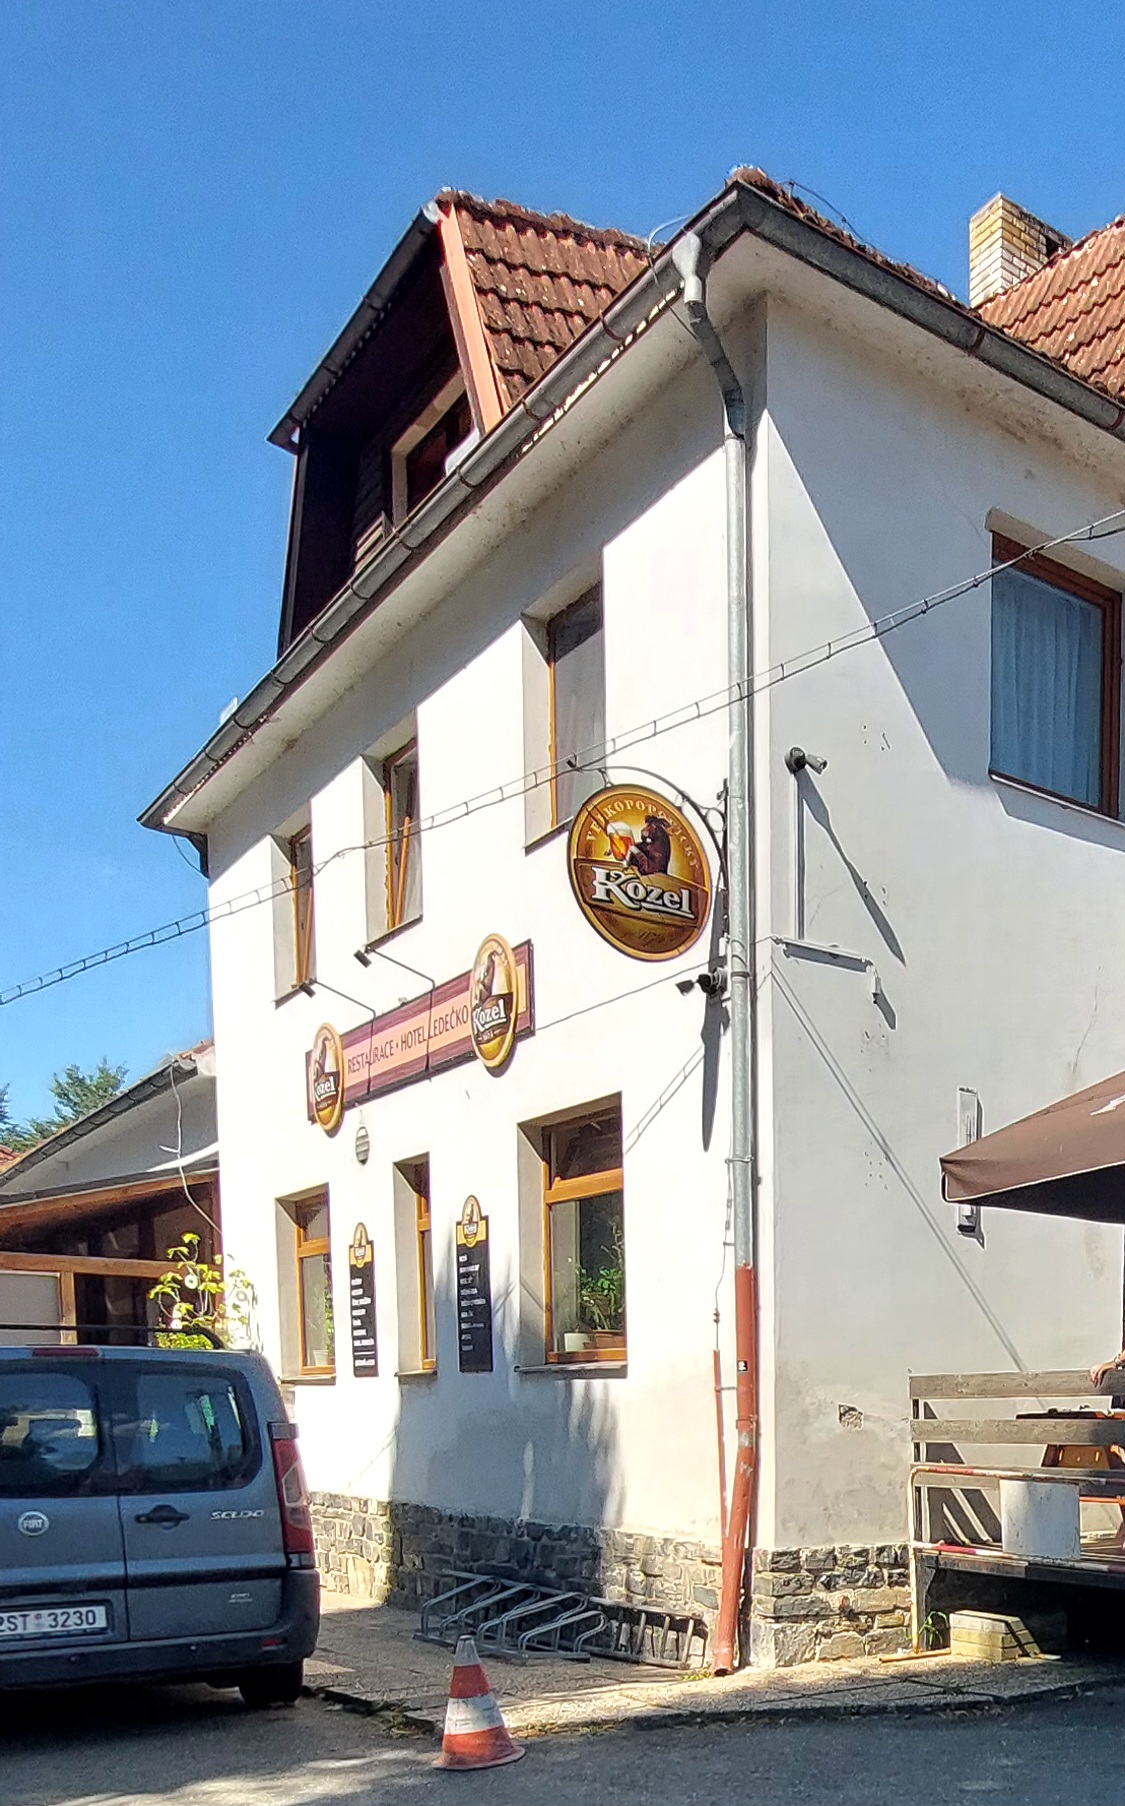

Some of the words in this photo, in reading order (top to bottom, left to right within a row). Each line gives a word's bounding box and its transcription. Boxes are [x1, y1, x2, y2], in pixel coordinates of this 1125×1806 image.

[592, 866, 695, 919] Kozel
[347, 1039, 394, 1075] RESTAURACE
[400, 1026, 425, 1052] HOTEL
[428, 1004, 469, 1040] LEDEČKO
[210, 1509, 265, 1520] SCUDO
[47, 1609, 97, 1629] 3230
